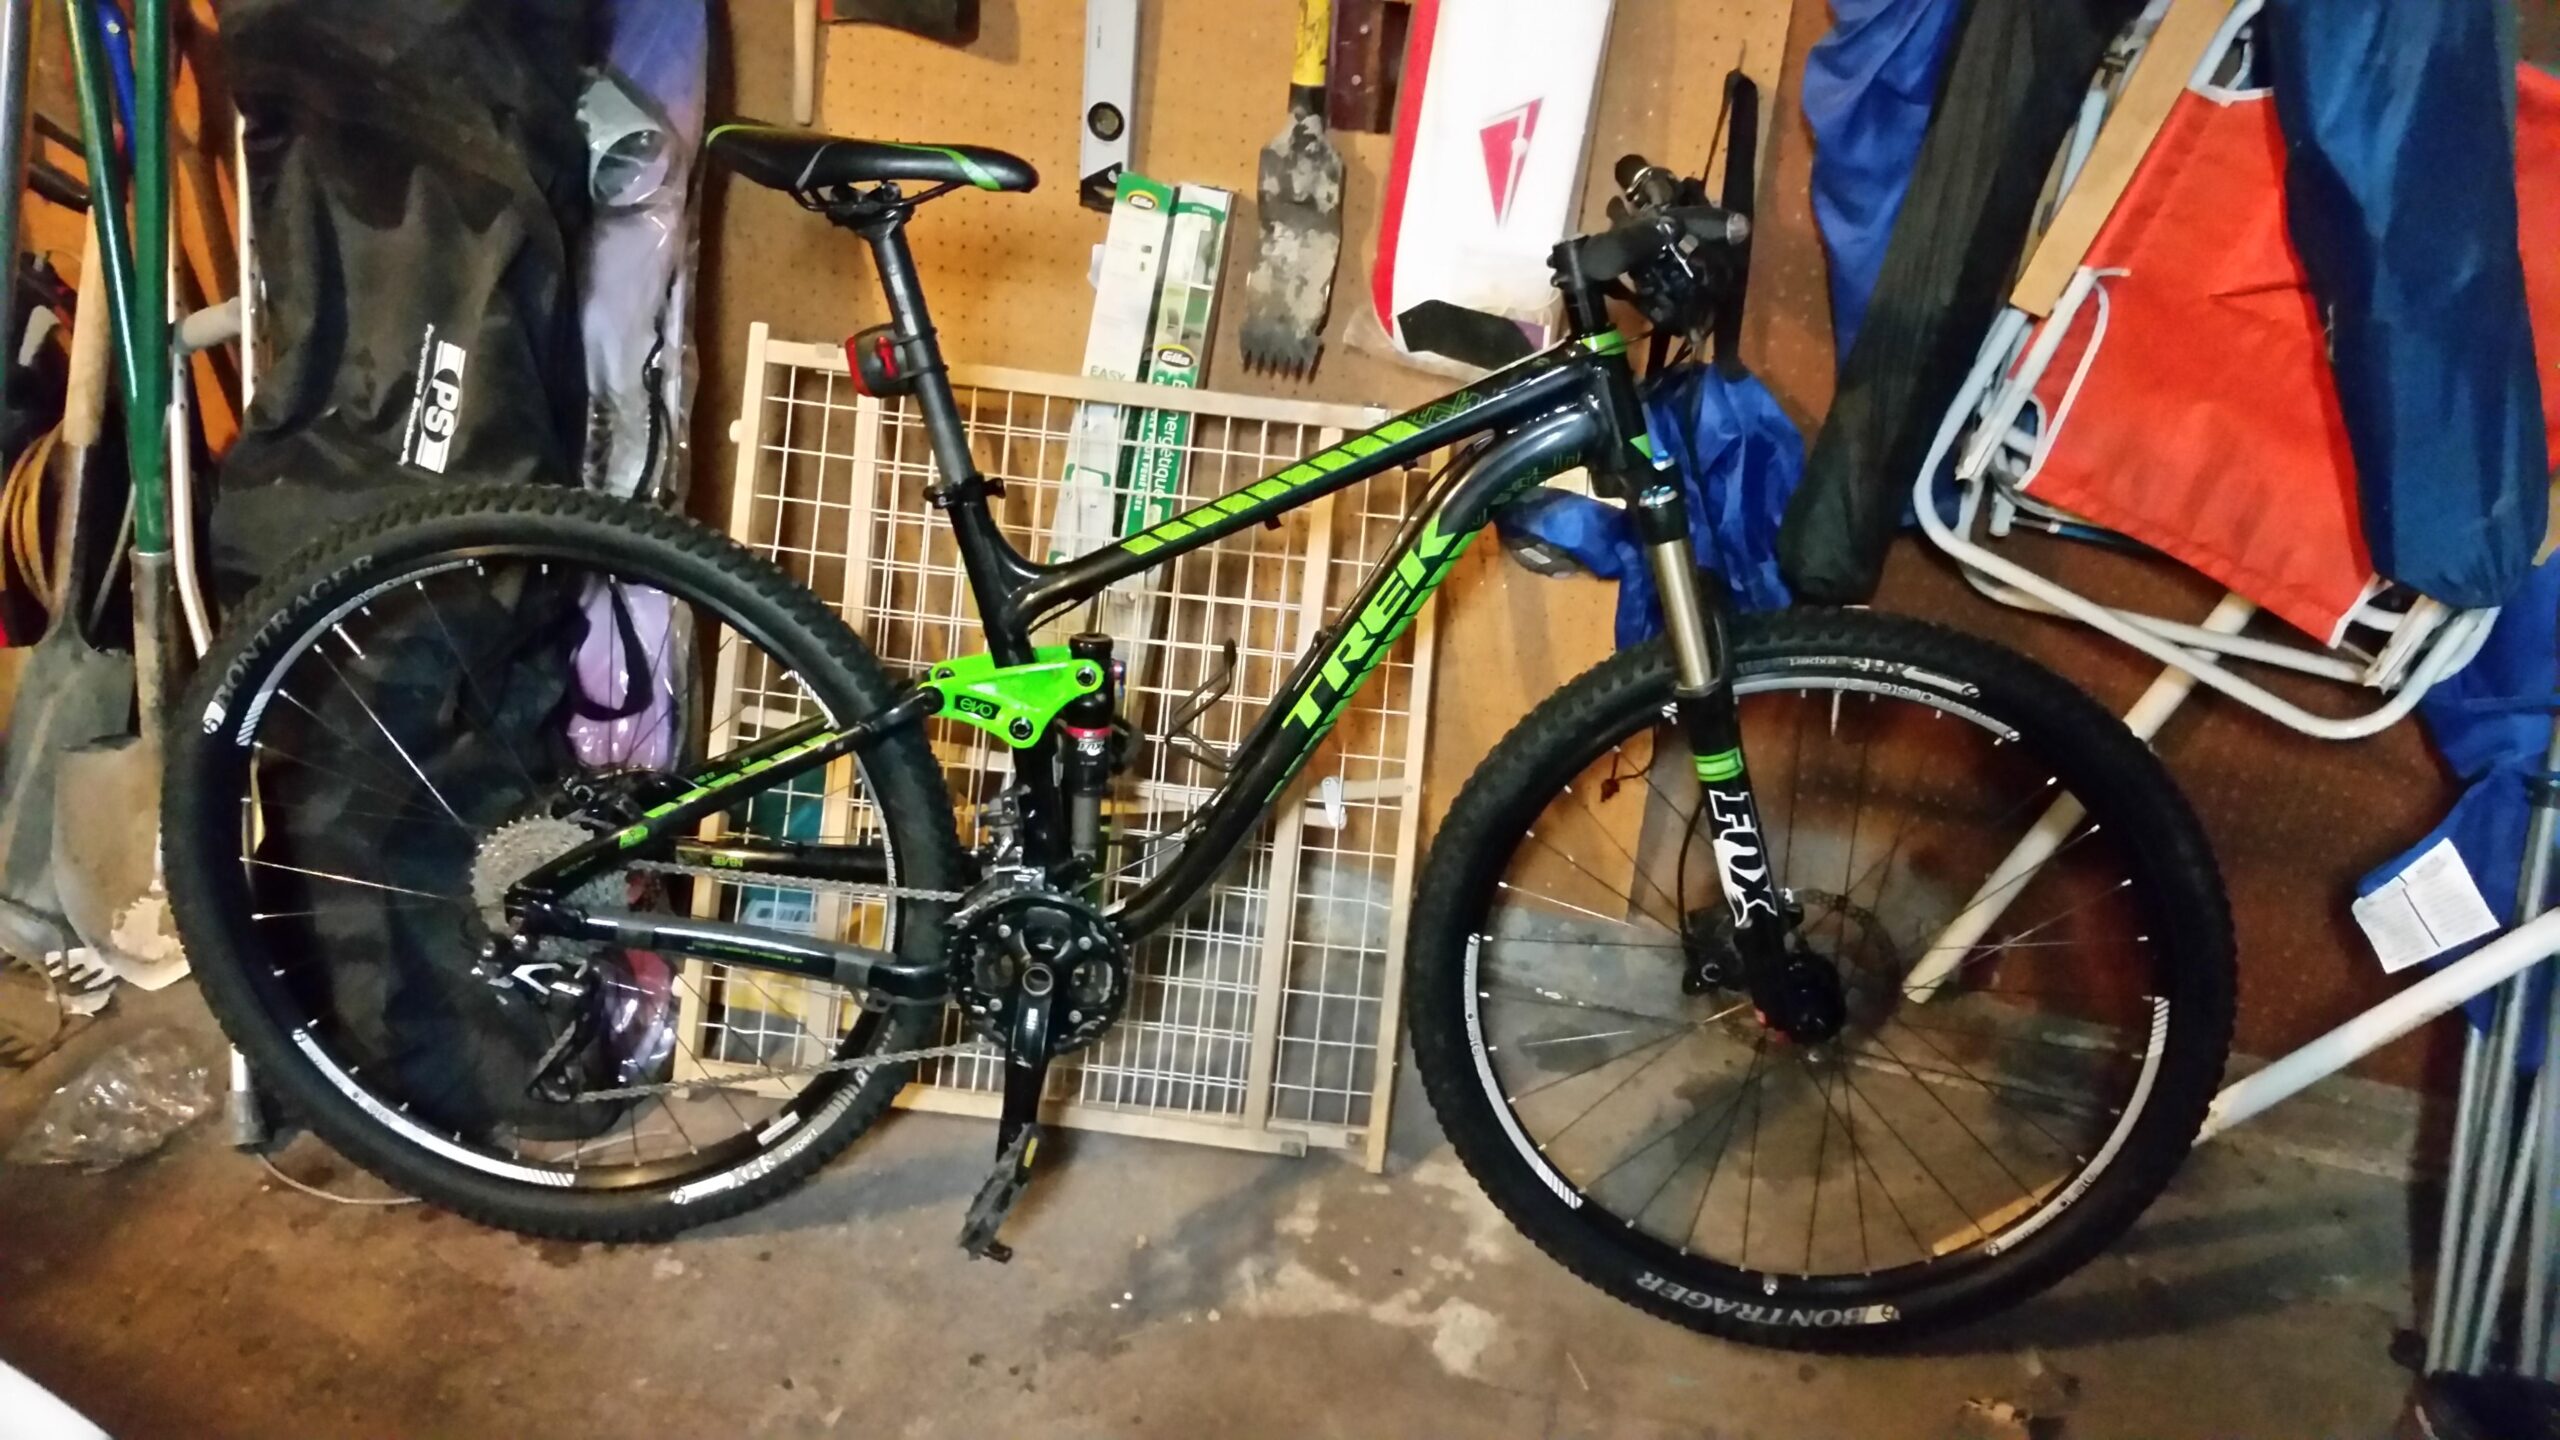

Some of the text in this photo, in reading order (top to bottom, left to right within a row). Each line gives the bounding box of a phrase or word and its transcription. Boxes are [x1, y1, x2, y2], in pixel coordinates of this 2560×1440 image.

[211, 554, 373, 706] BONTRAGER
[1282, 511, 1457, 729] TREK
[959, 697, 993, 718] evo
[1708, 789, 1778, 927] FOX
[1636, 1270, 1869, 1328] BONTRAGER
